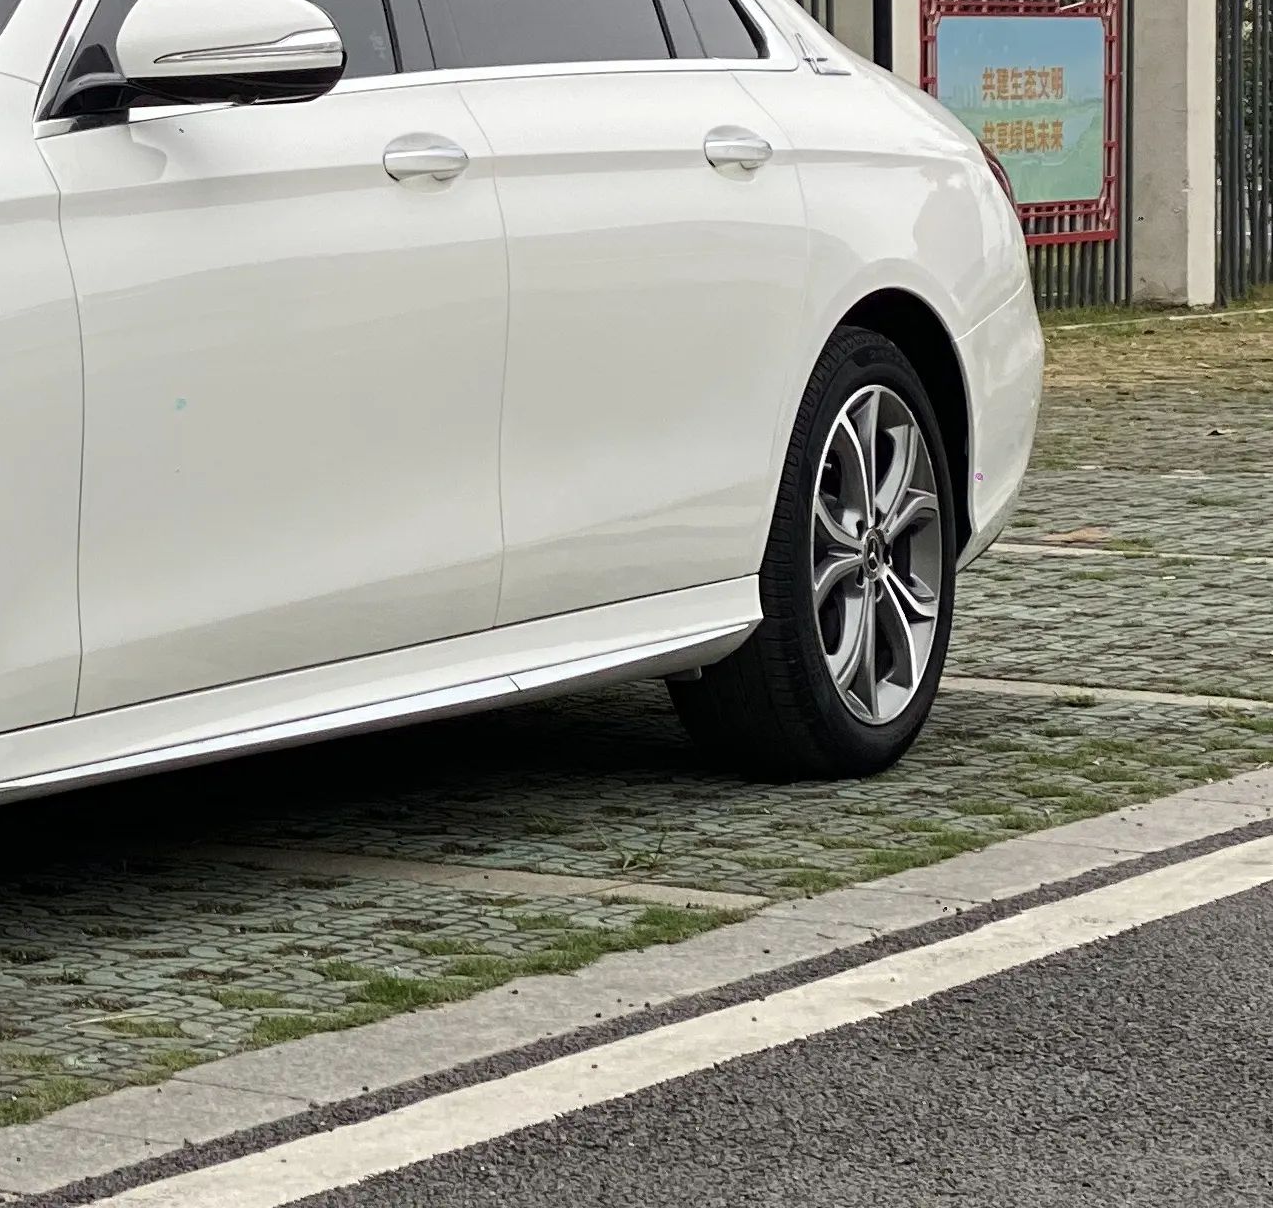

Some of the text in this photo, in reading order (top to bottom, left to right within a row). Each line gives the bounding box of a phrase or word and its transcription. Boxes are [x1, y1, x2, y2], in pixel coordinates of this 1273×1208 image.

[982, 66, 1063, 100] 共建生态文明
[982, 118, 1063, 154] 共享绿色未来
